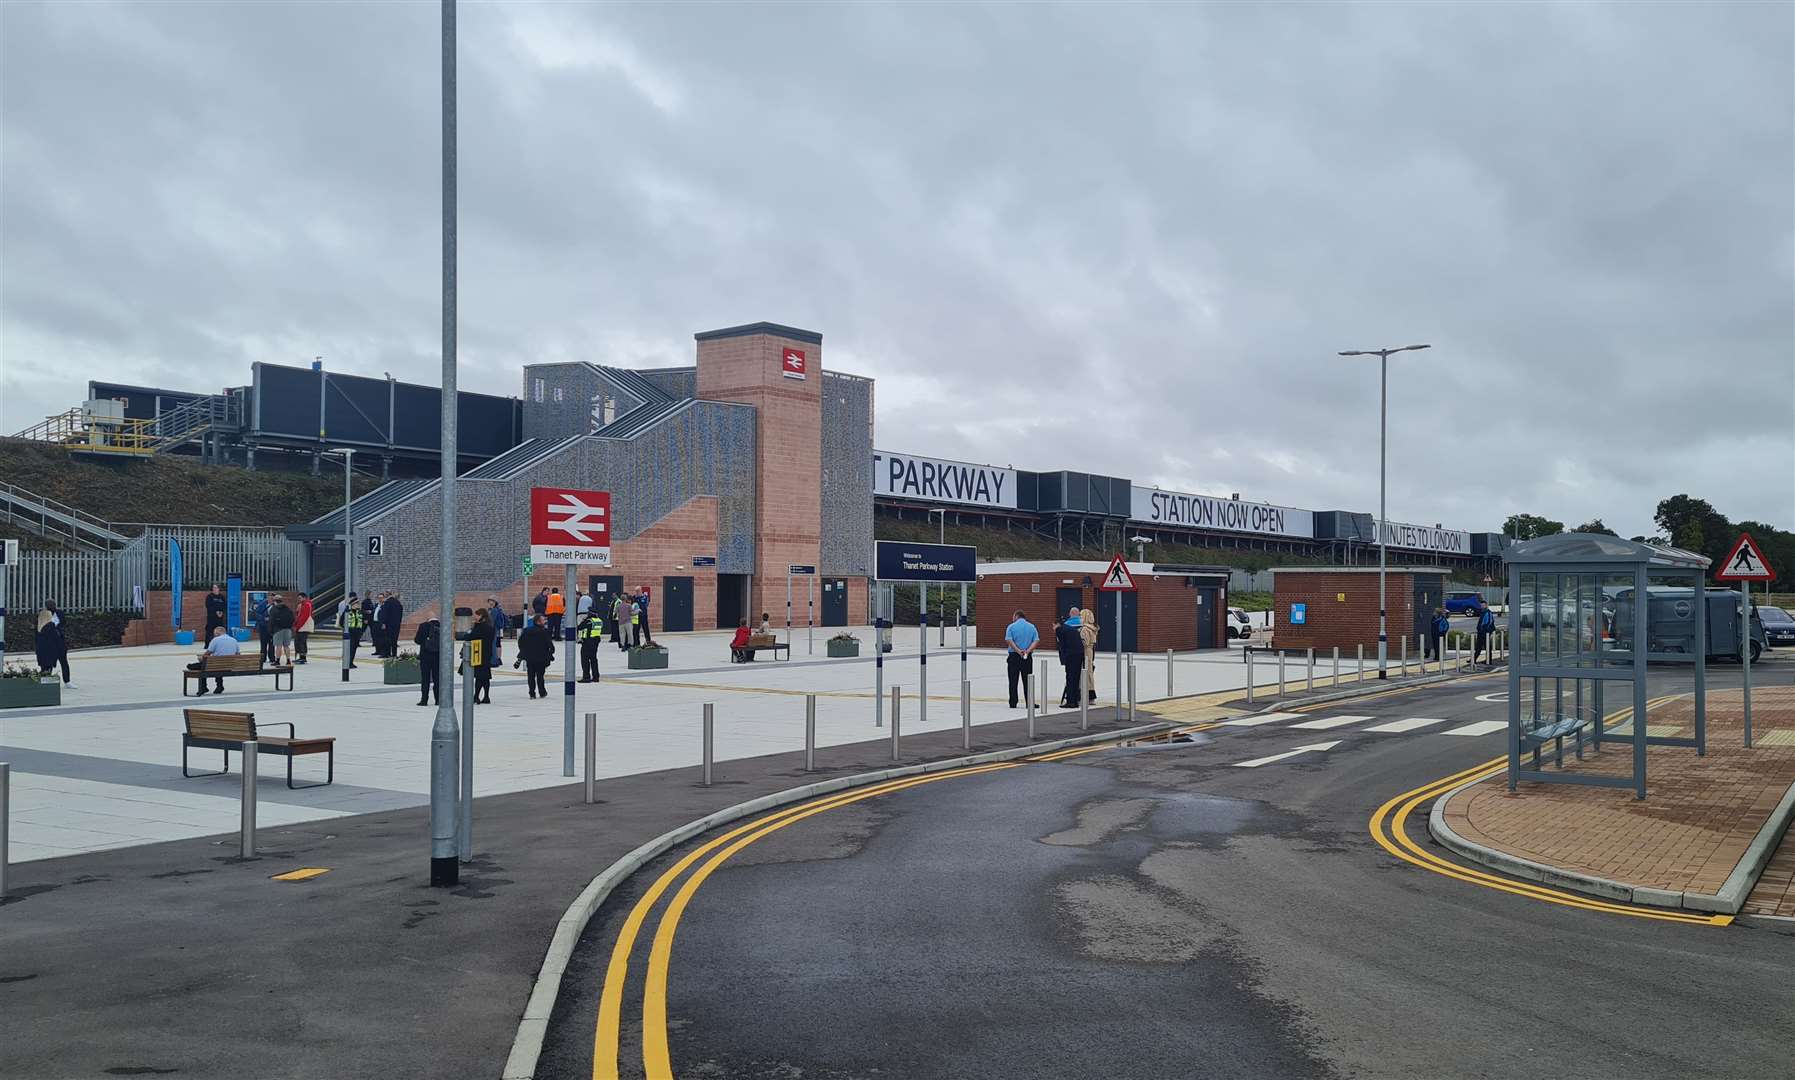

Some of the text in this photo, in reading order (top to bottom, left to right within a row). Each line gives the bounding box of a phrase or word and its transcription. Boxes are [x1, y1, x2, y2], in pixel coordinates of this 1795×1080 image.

[889, 457, 1005, 504] PARKWAY
[1151, 492, 1284, 533] STATION NOW OPEN
[371, 538, 379, 553] 2
[1417, 527, 1428, 548] TO
[1429, 528, 1461, 551] LONDON
[544, 549, 608, 562] Thanet Parkway
[903, 561, 954, 572] Thanet Parkway Station
